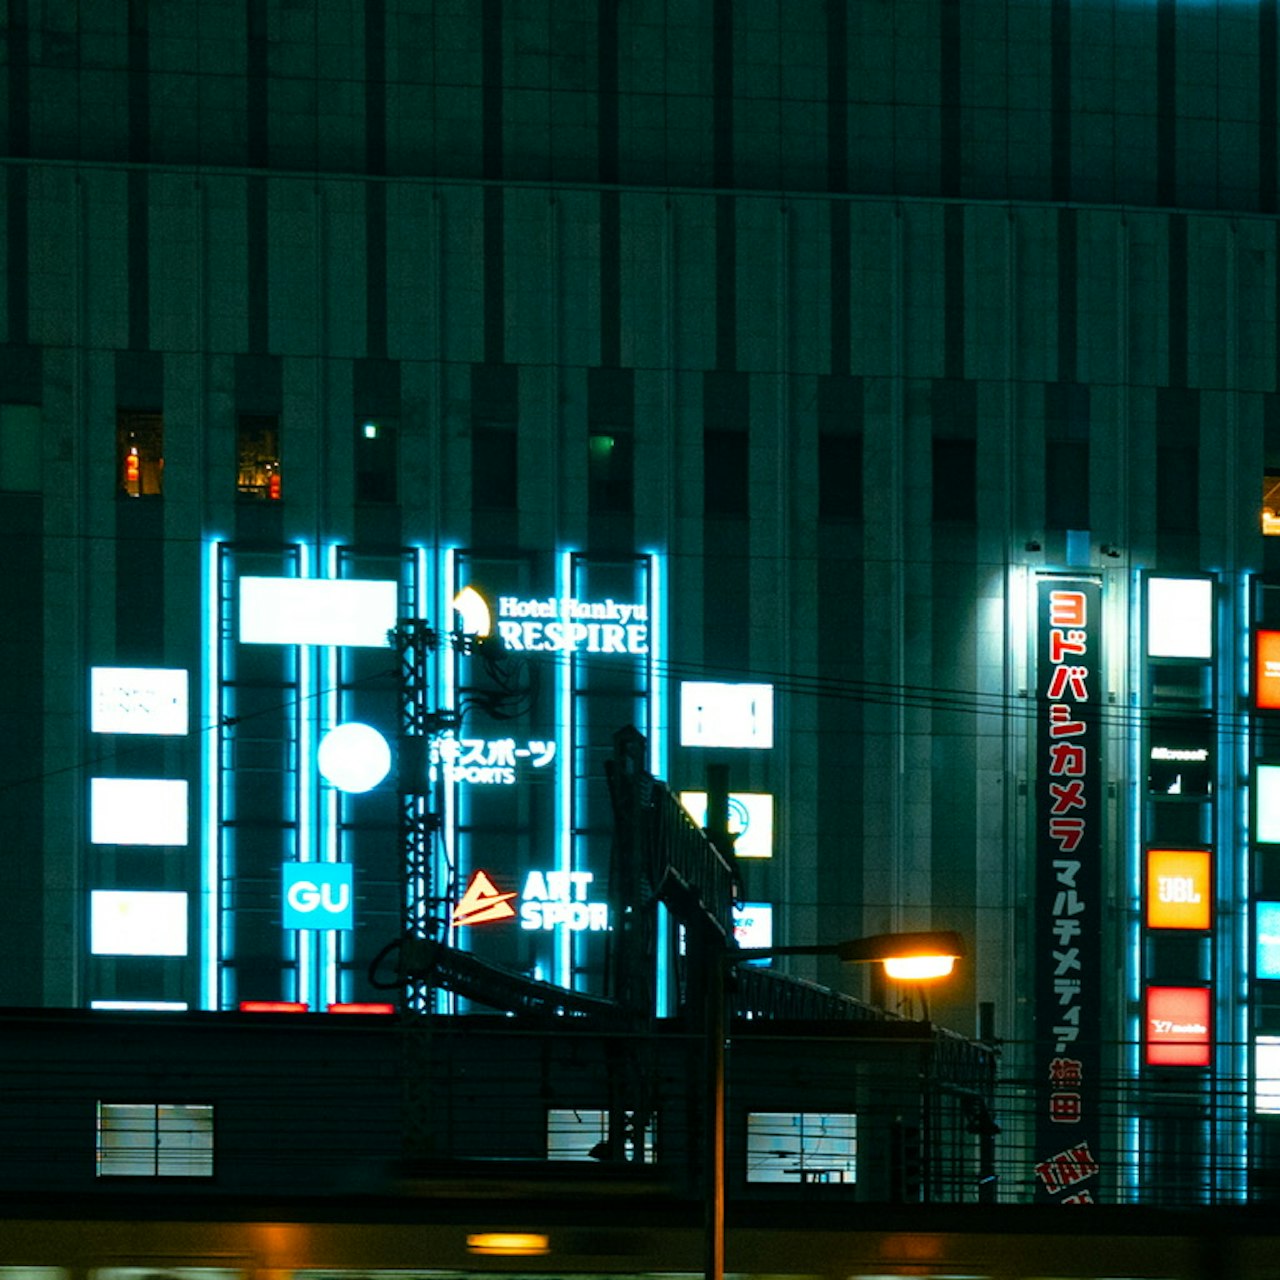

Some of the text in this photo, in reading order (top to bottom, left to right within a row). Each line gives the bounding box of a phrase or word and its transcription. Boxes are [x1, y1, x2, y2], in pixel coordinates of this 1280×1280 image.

[499, 597, 648, 624] Hotel Hankyu
[499, 621, 648, 653] RESPIRE
[287, 880, 350, 913] GU
[525, 871, 593, 901] ART
[1157, 877, 1201, 904] JBL
